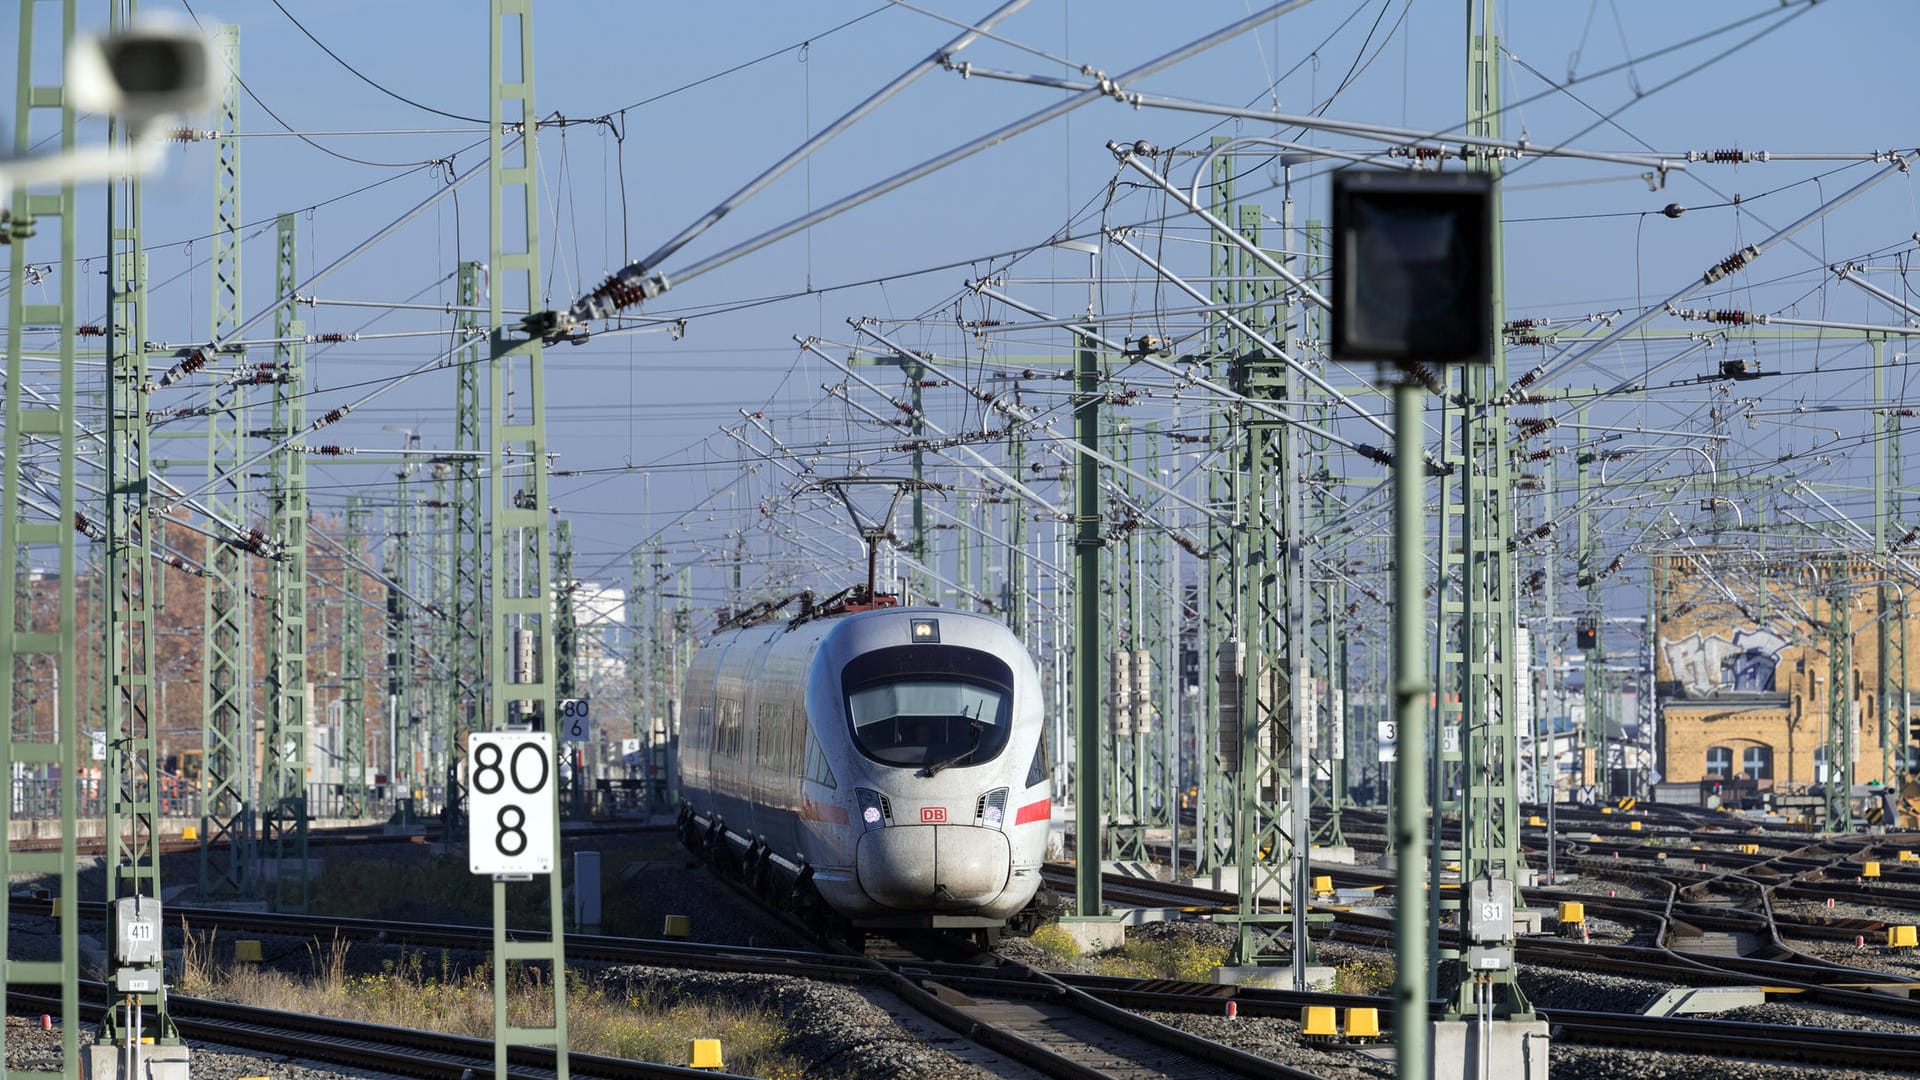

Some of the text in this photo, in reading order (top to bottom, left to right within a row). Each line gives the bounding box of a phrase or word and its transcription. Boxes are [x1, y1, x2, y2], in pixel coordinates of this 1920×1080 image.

[564, 701, 589, 718] 80
[571, 720, 582, 737] 6
[473, 742, 549, 795] 80
[923, 809, 944, 820] DB
[495, 804, 528, 857] 8
[1483, 904, 1500, 919] 31
[132, 925, 149, 939] 411
